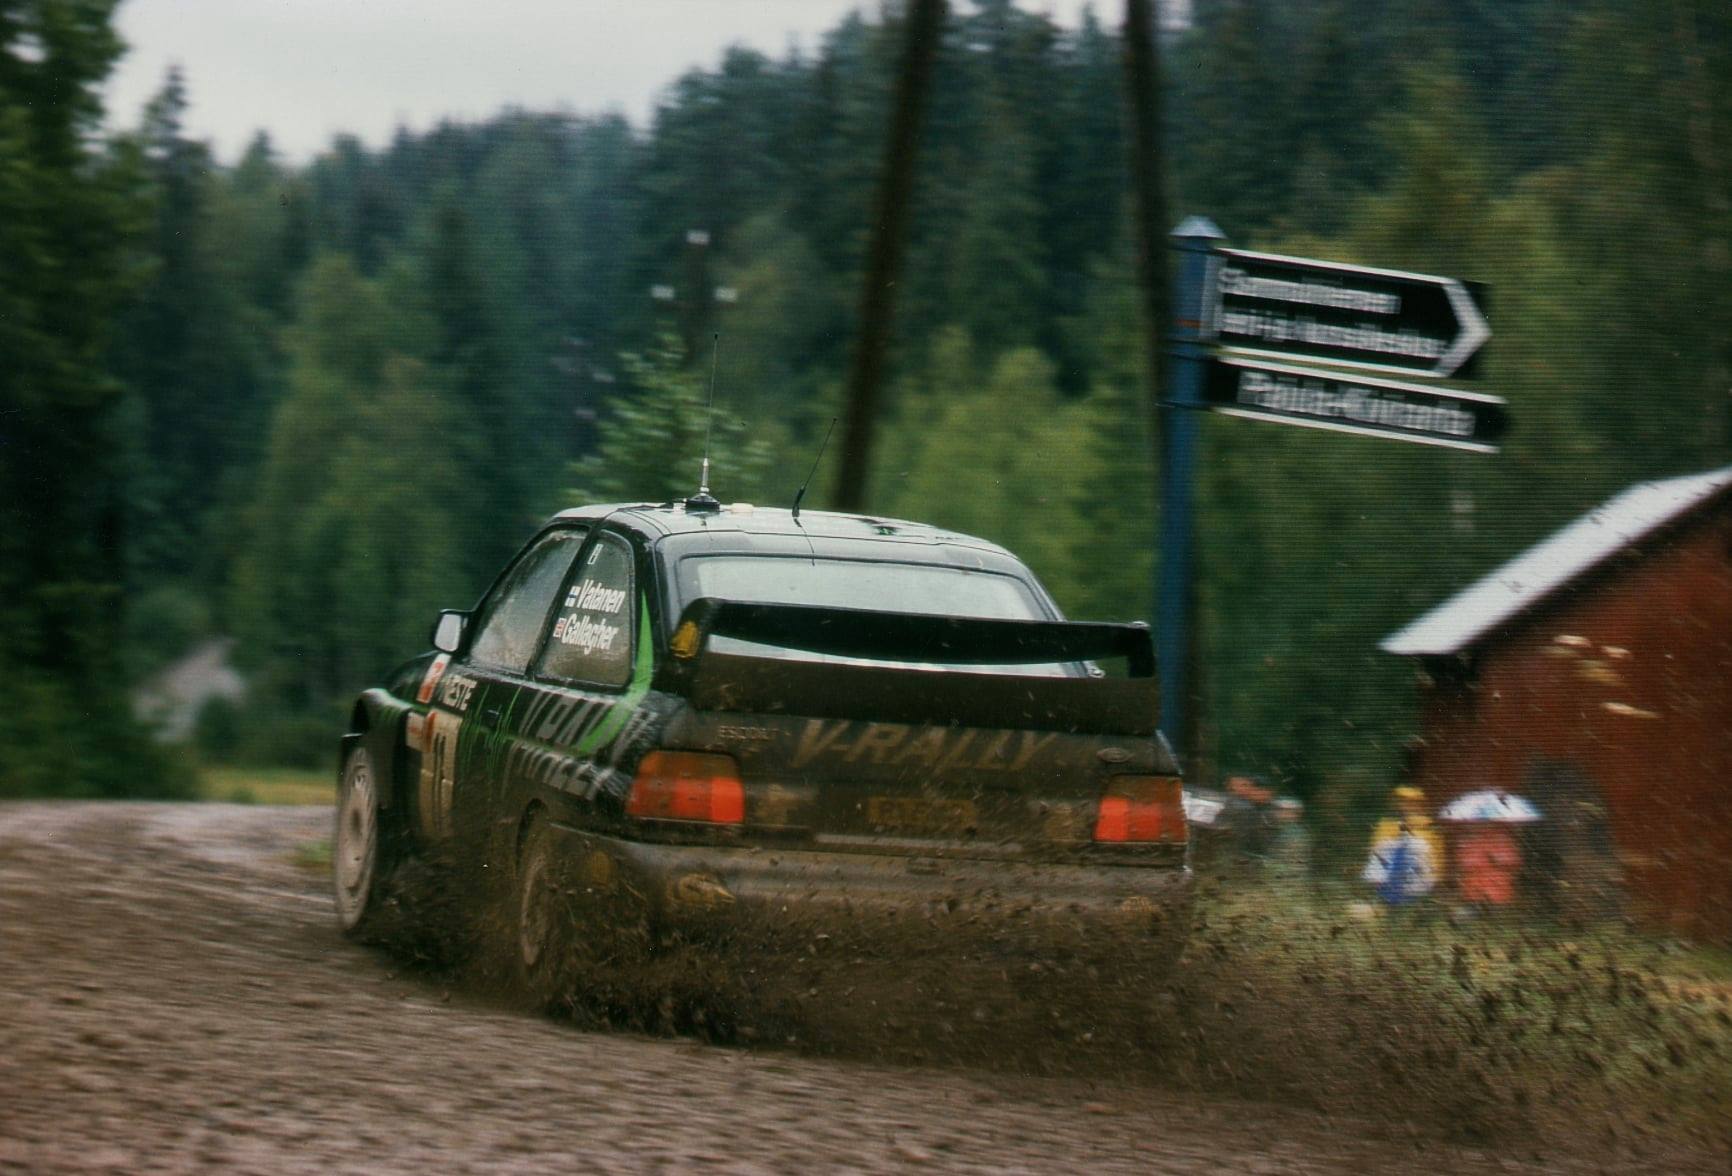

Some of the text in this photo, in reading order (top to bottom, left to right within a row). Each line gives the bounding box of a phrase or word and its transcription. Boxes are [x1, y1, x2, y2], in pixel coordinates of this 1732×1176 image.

[577, 579, 626, 613] Vatanen
[561, 613, 619, 655] Gallagher
[790, 718, 1056, 770] V-RALLY
